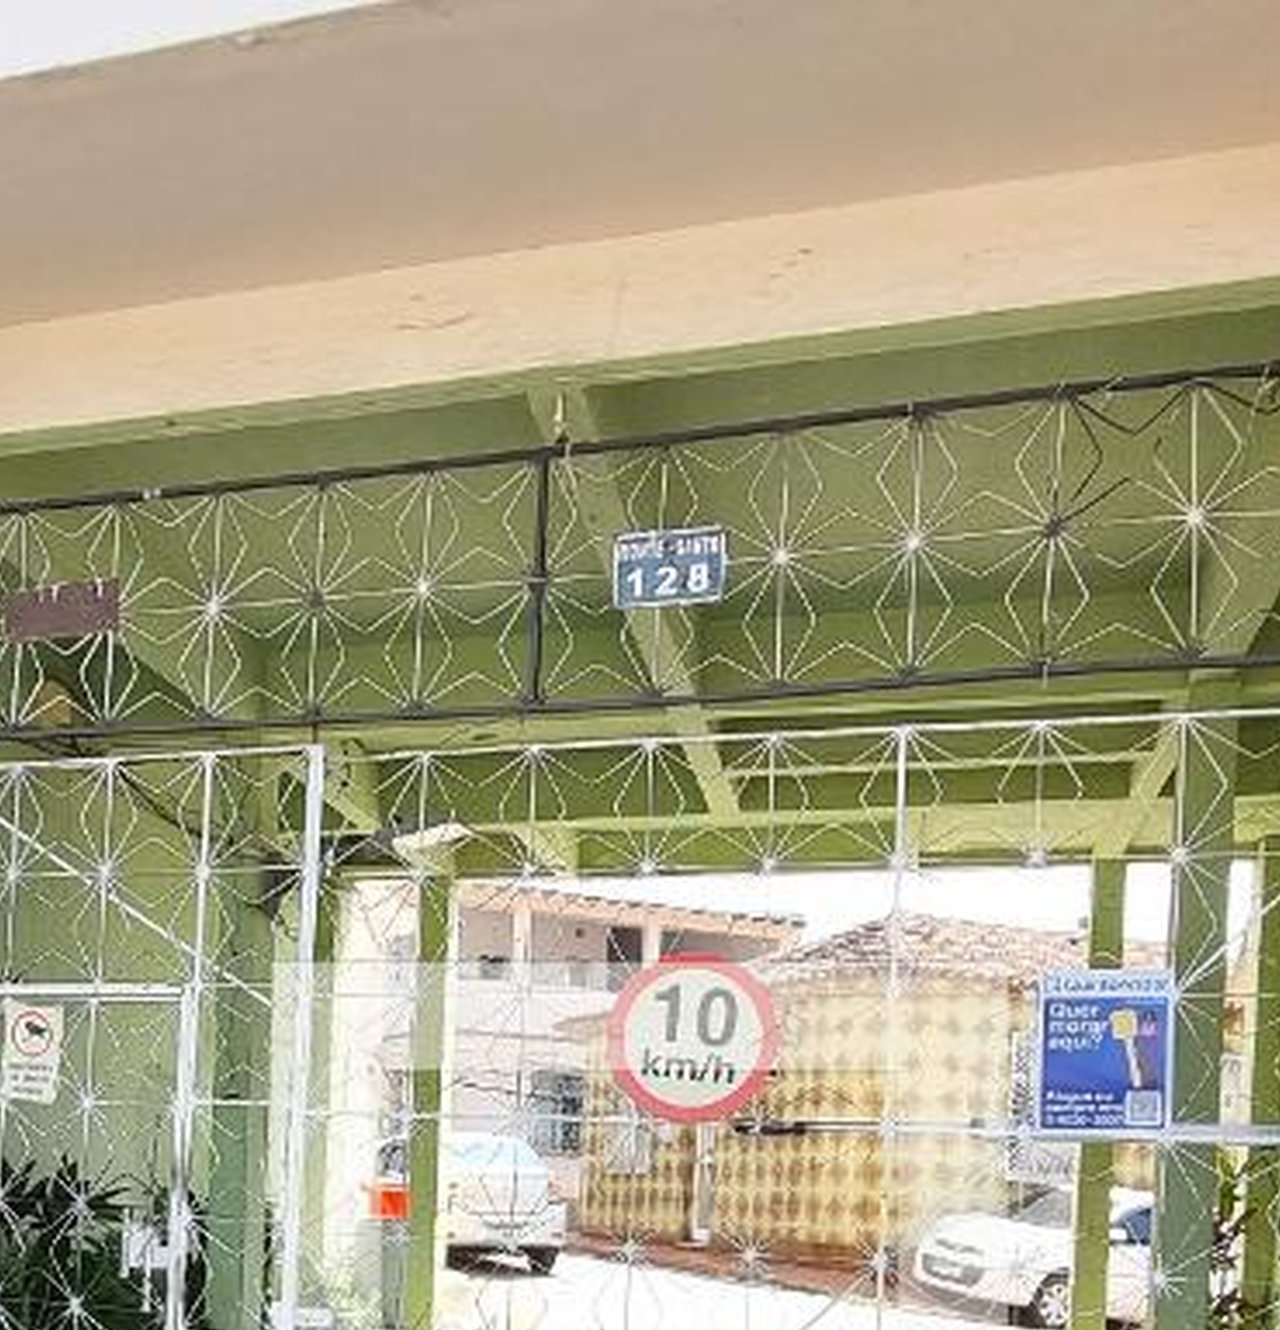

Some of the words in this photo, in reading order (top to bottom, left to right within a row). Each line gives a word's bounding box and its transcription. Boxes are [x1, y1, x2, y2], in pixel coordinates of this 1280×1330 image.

[626, 562, 709, 598] 128
[654, 984, 739, 1046] 10
[641, 1047, 736, 1084] km/h
